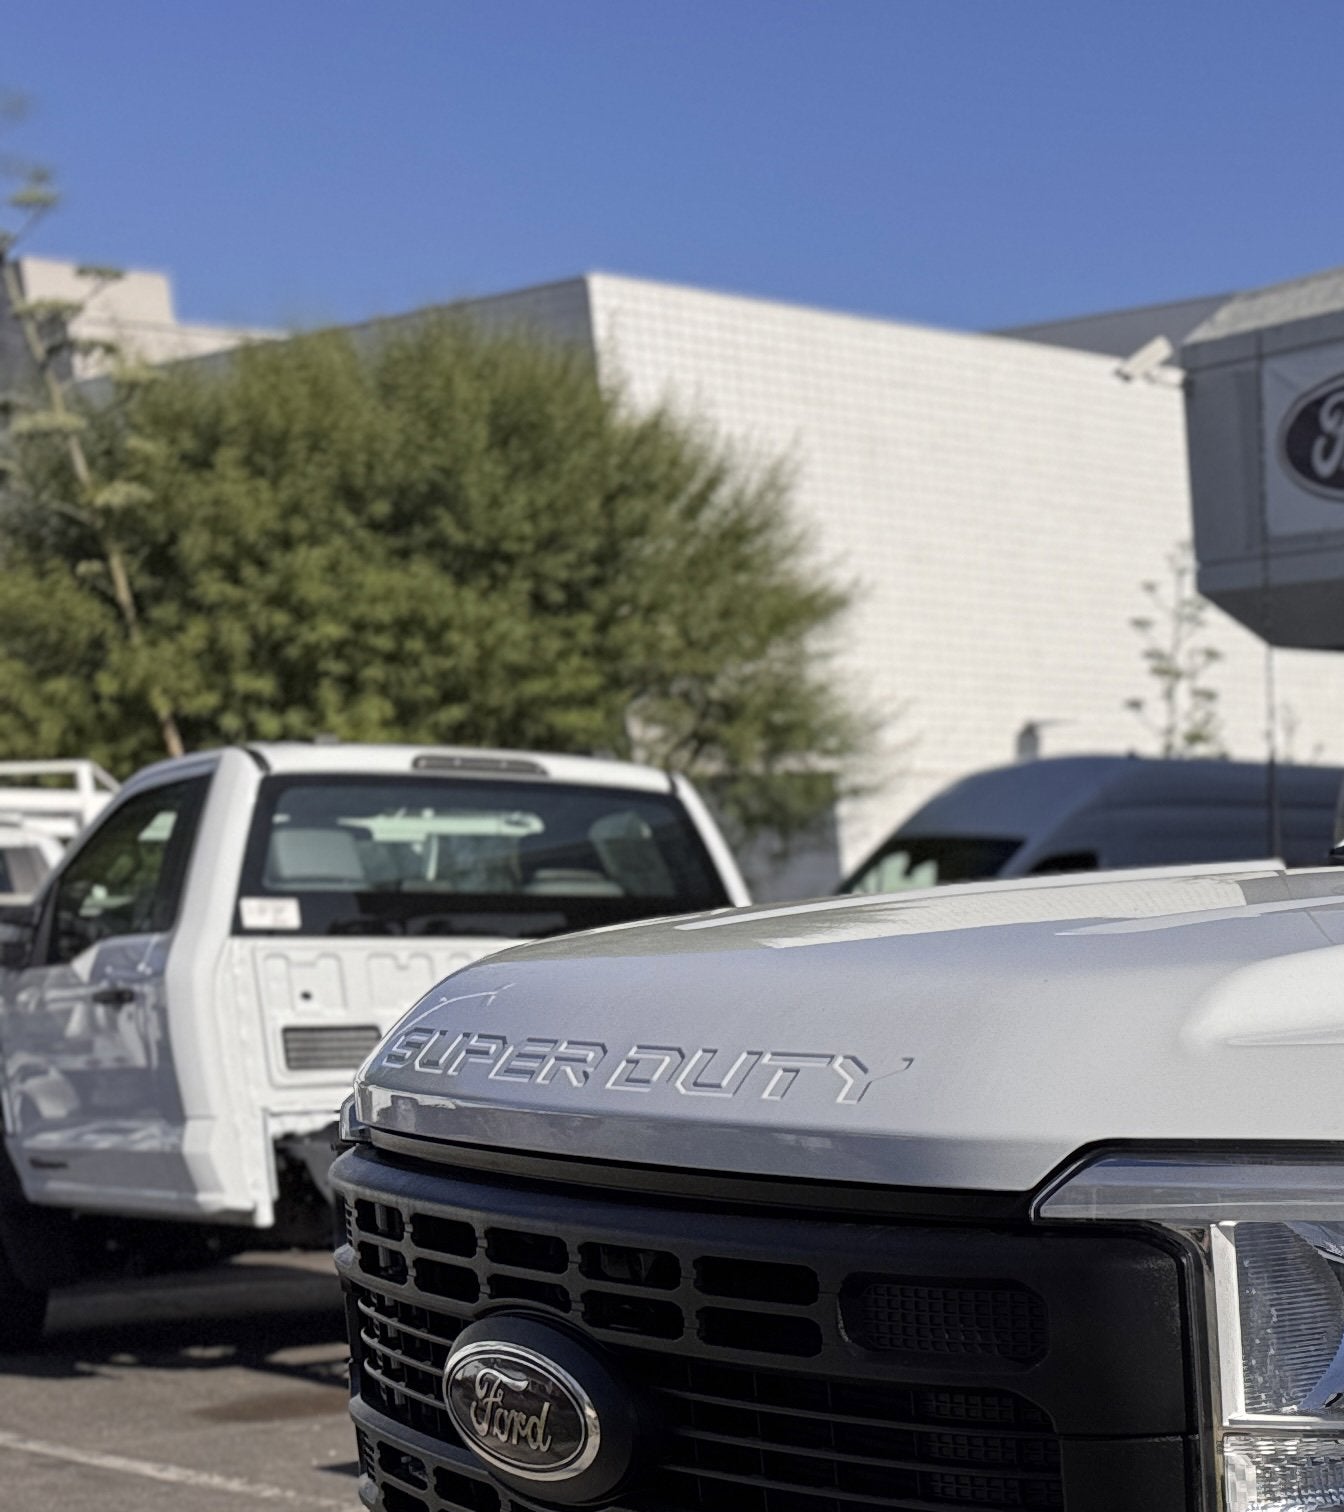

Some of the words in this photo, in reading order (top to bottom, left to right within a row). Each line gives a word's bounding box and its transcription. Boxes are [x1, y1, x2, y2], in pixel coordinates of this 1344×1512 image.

[382, 1026, 608, 1088] SUPER
[605, 1043, 914, 1104] DUTY
[470, 1367, 552, 1452] Ford
